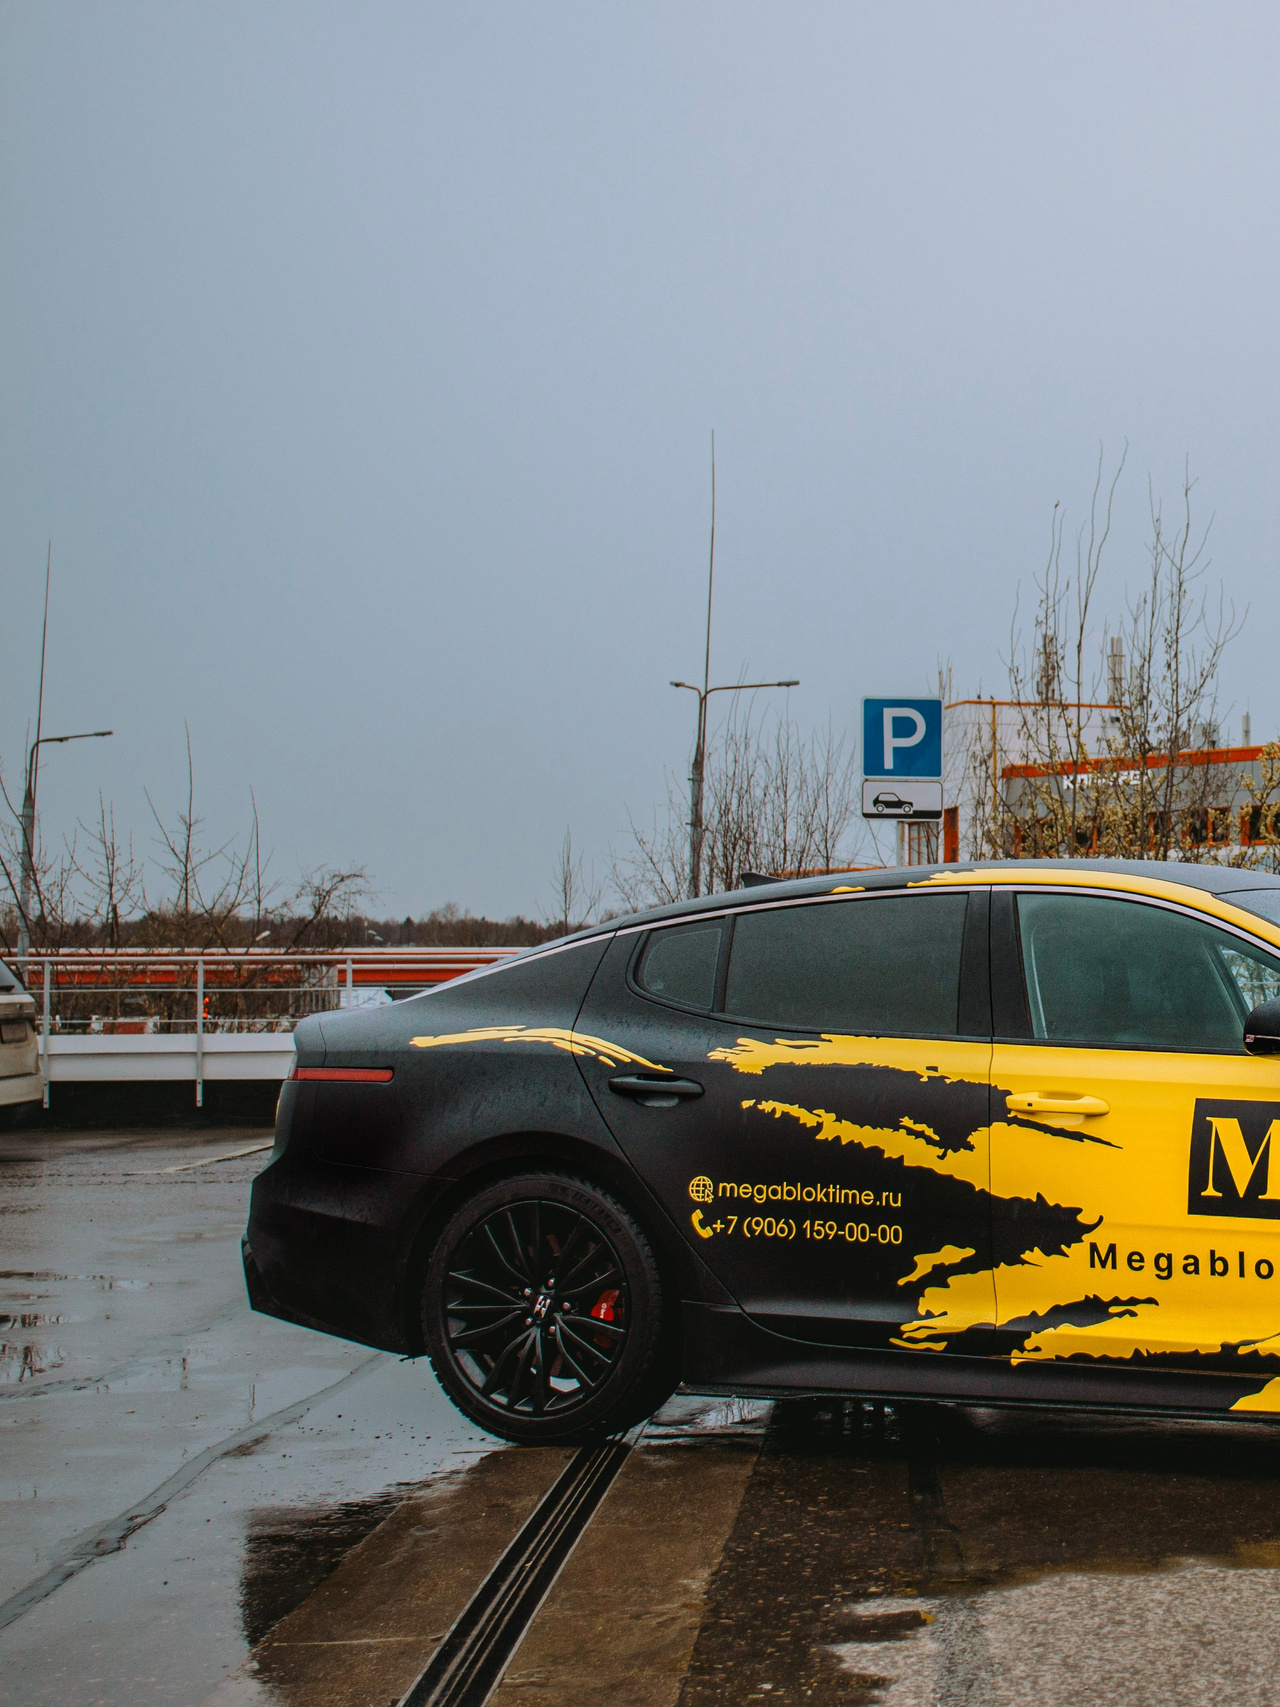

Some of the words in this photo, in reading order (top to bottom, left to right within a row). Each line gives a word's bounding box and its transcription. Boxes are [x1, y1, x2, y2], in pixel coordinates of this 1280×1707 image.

[883, 707, 926, 769] P
[718, 1181, 902, 1207] megabloktime.ru
[712, 1215, 738, 1235] +7
[743, 1216, 796, 1240] (906)
[802, 1219, 903, 1244] 159-00-00
